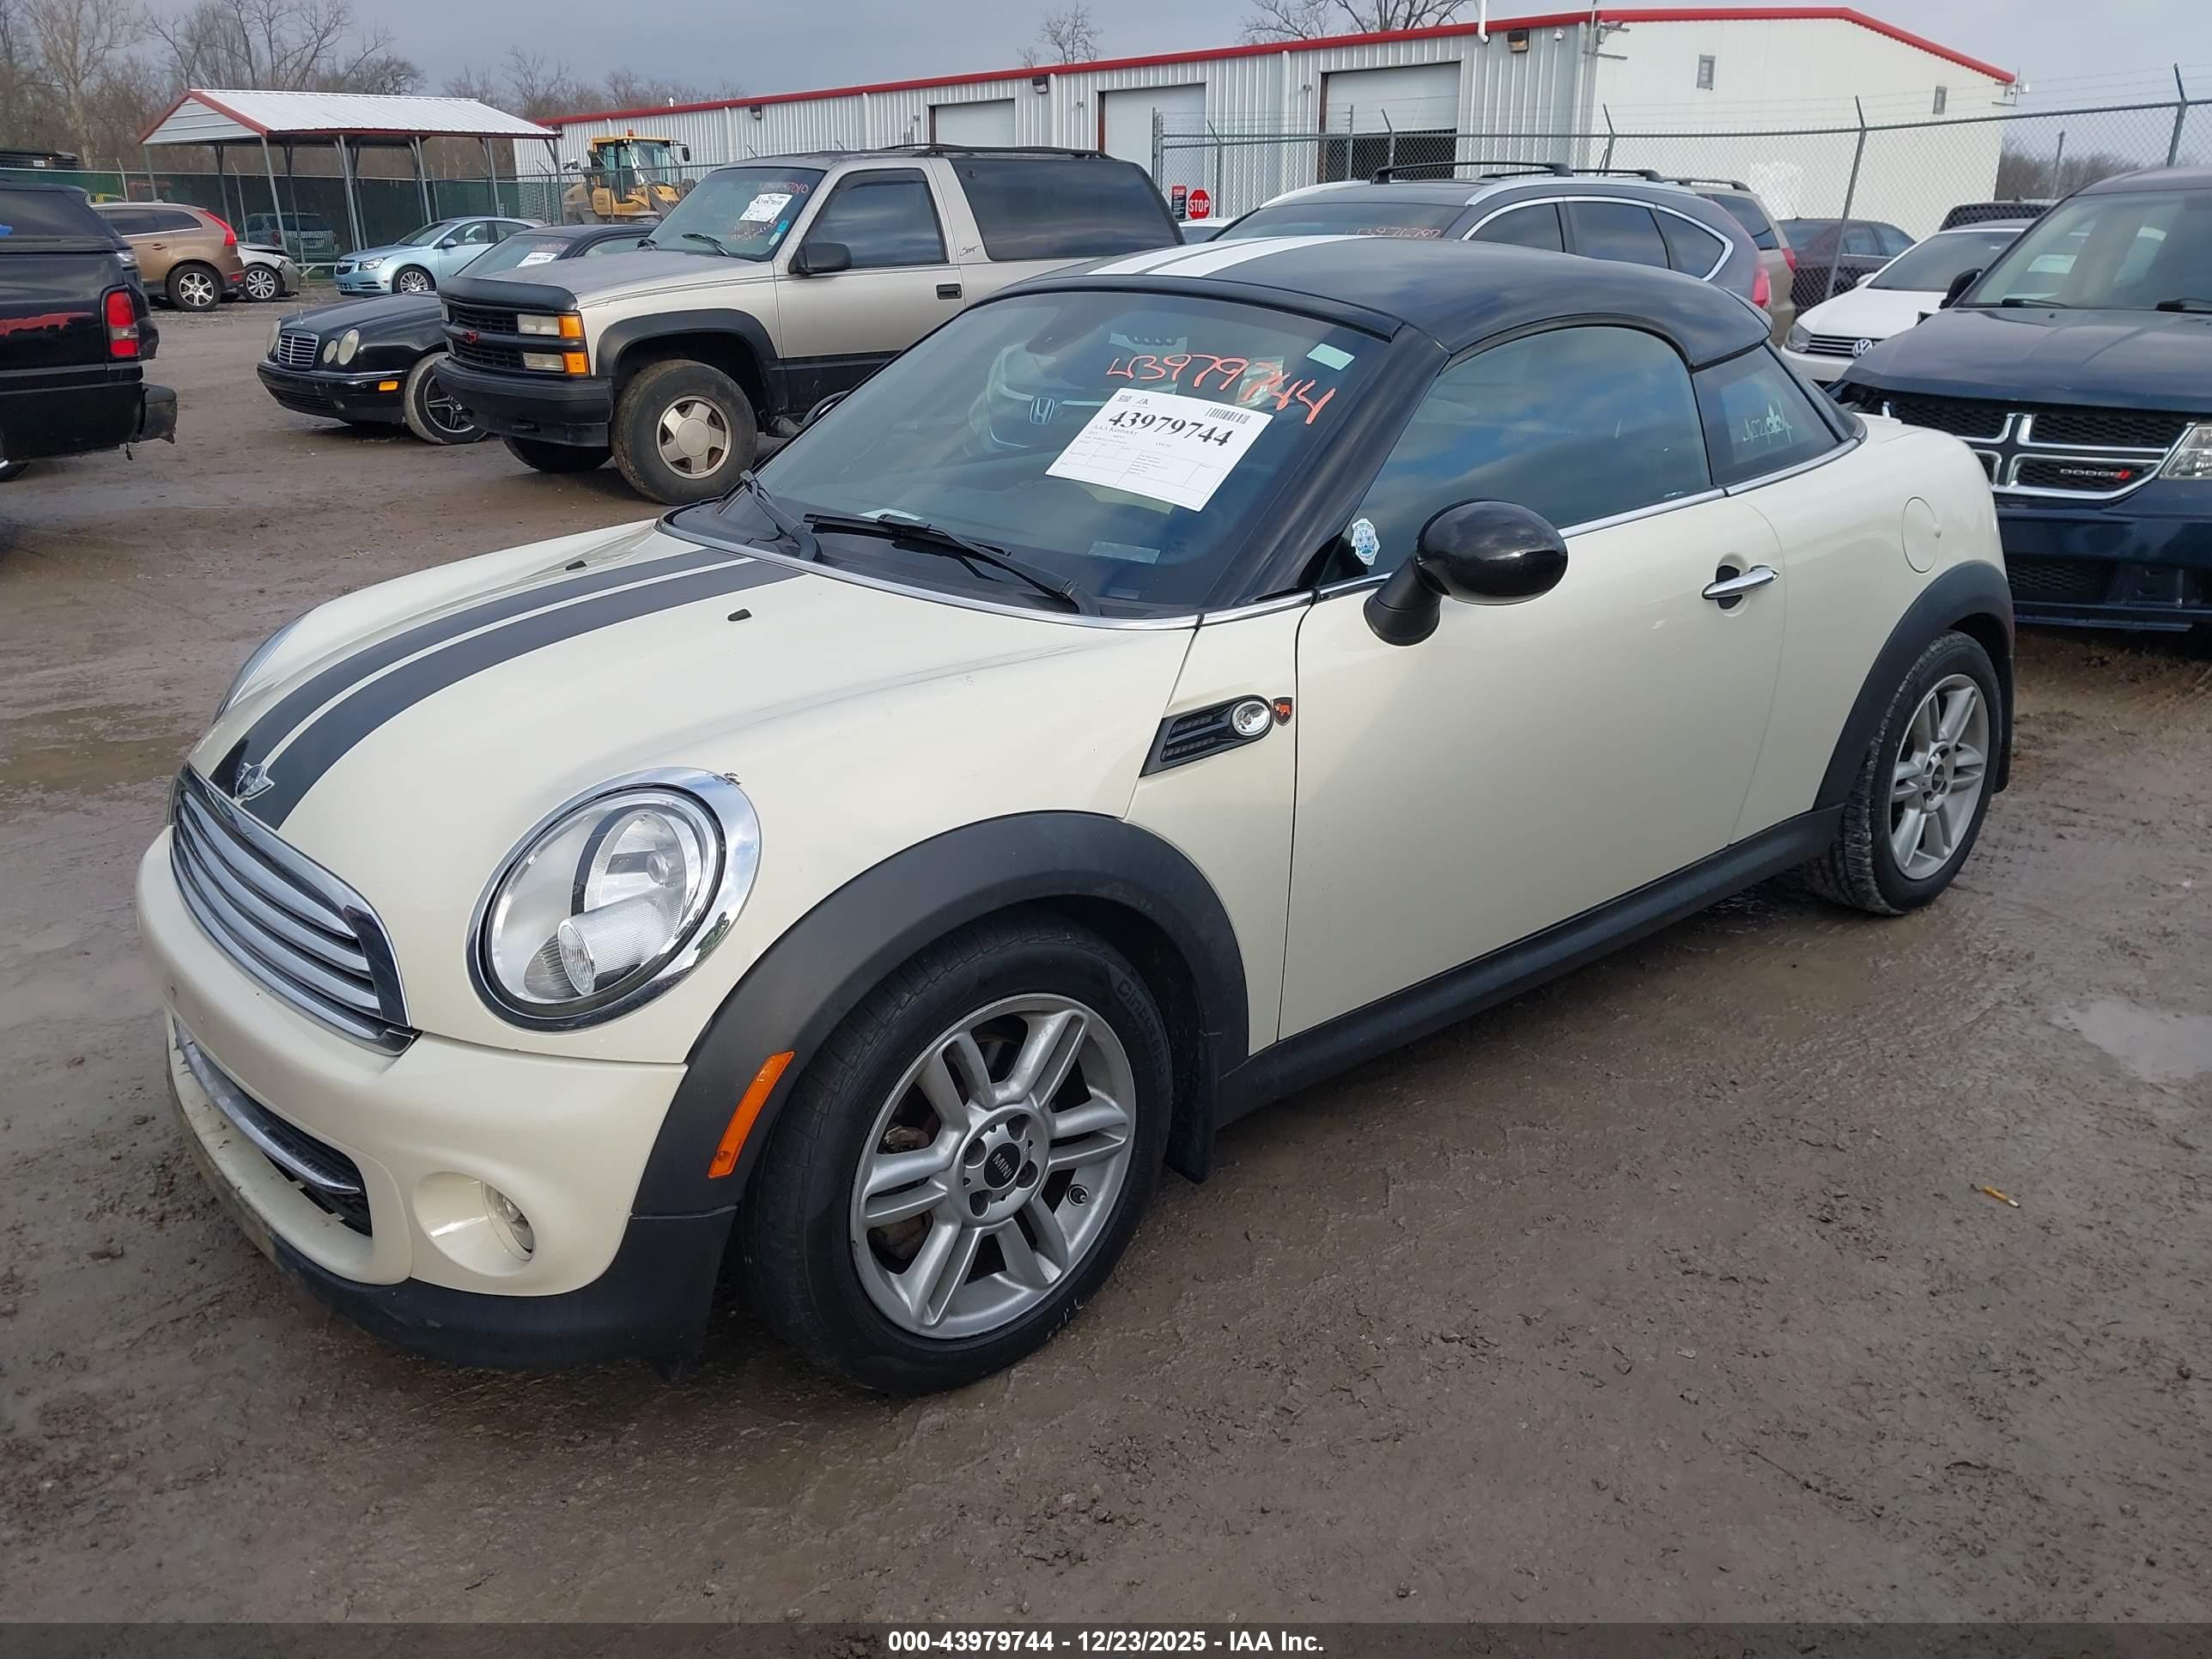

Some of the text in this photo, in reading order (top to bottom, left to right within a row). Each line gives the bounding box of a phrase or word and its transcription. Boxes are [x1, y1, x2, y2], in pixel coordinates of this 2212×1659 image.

[1188, 199, 1210, 213] STOP
[1106, 354, 1337, 425] 43979744
[1109, 410, 1234, 447] 43979744
[2060, 468, 2121, 477] DODGE
[992, 1152, 1013, 1180] MINI
